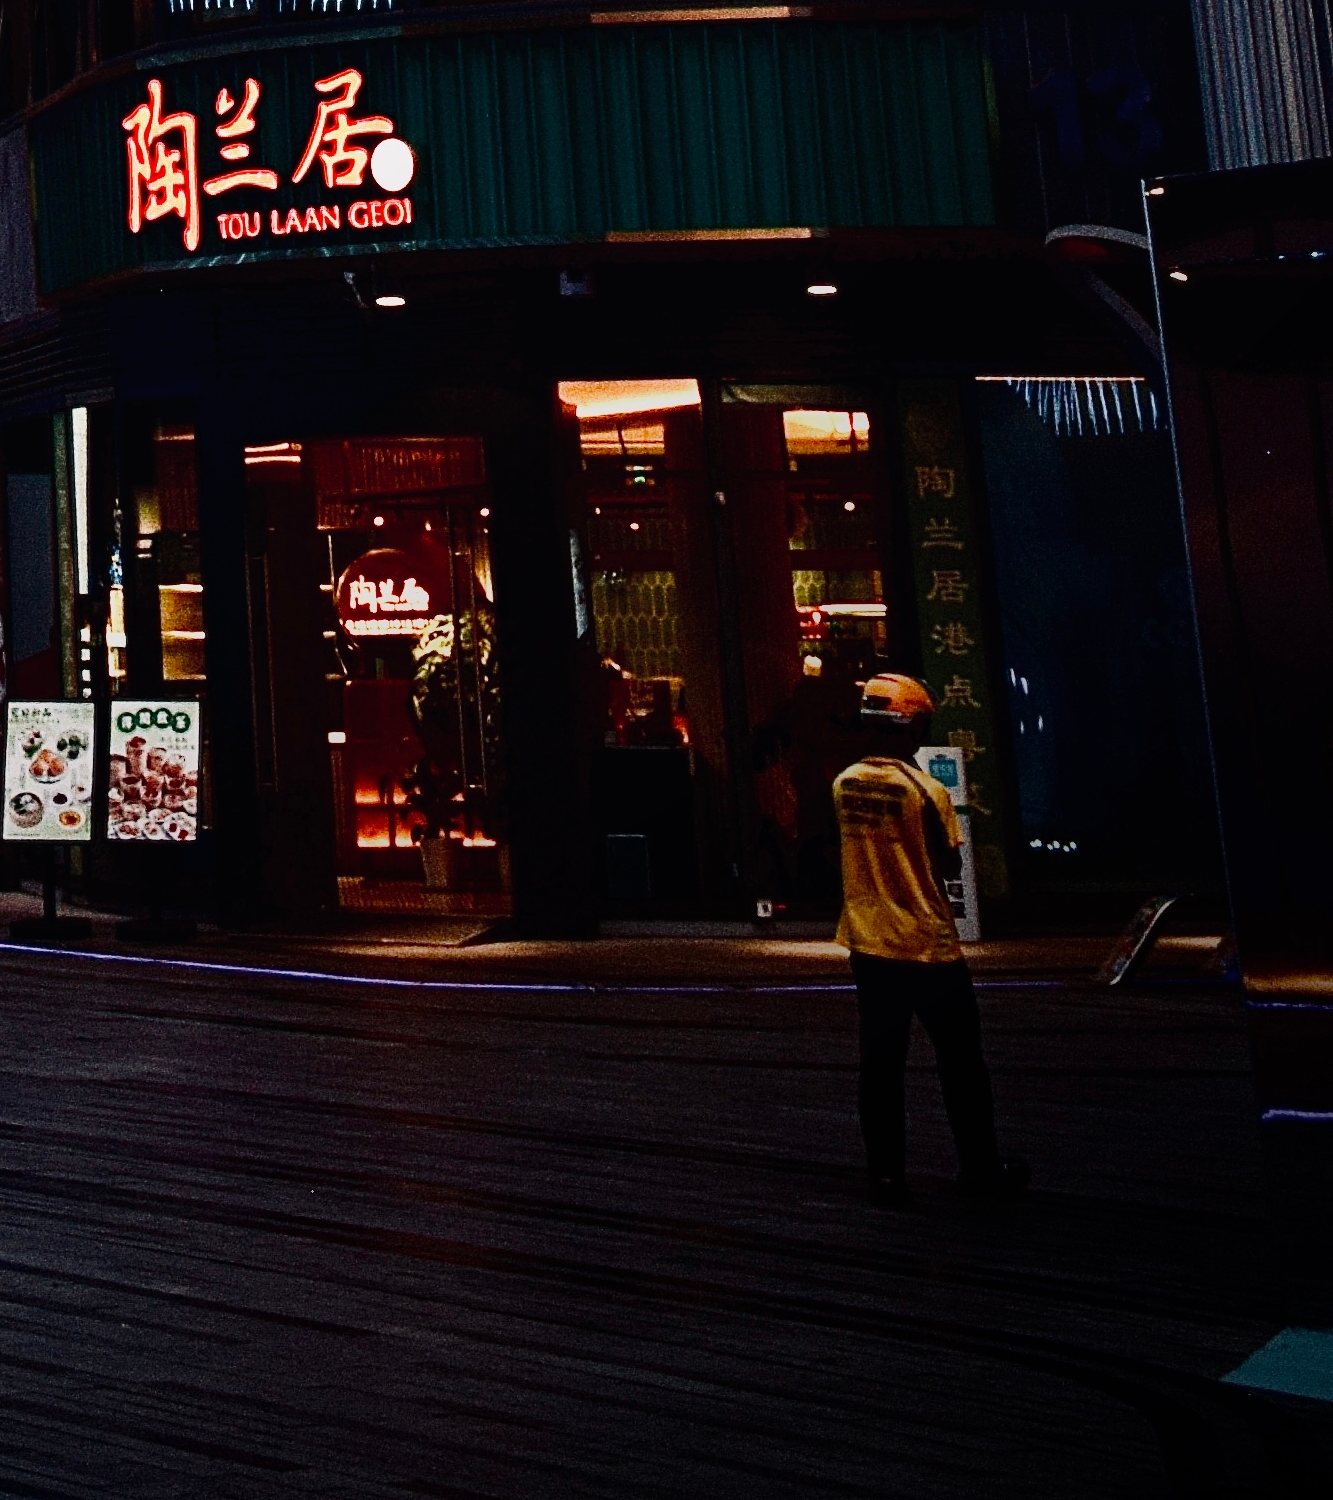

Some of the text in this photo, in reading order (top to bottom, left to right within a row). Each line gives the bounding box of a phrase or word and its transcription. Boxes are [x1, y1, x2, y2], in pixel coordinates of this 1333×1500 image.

[122, 68, 393, 252] 陶兰居
[217, 198, 413, 240] TOU LAAN GEOI
